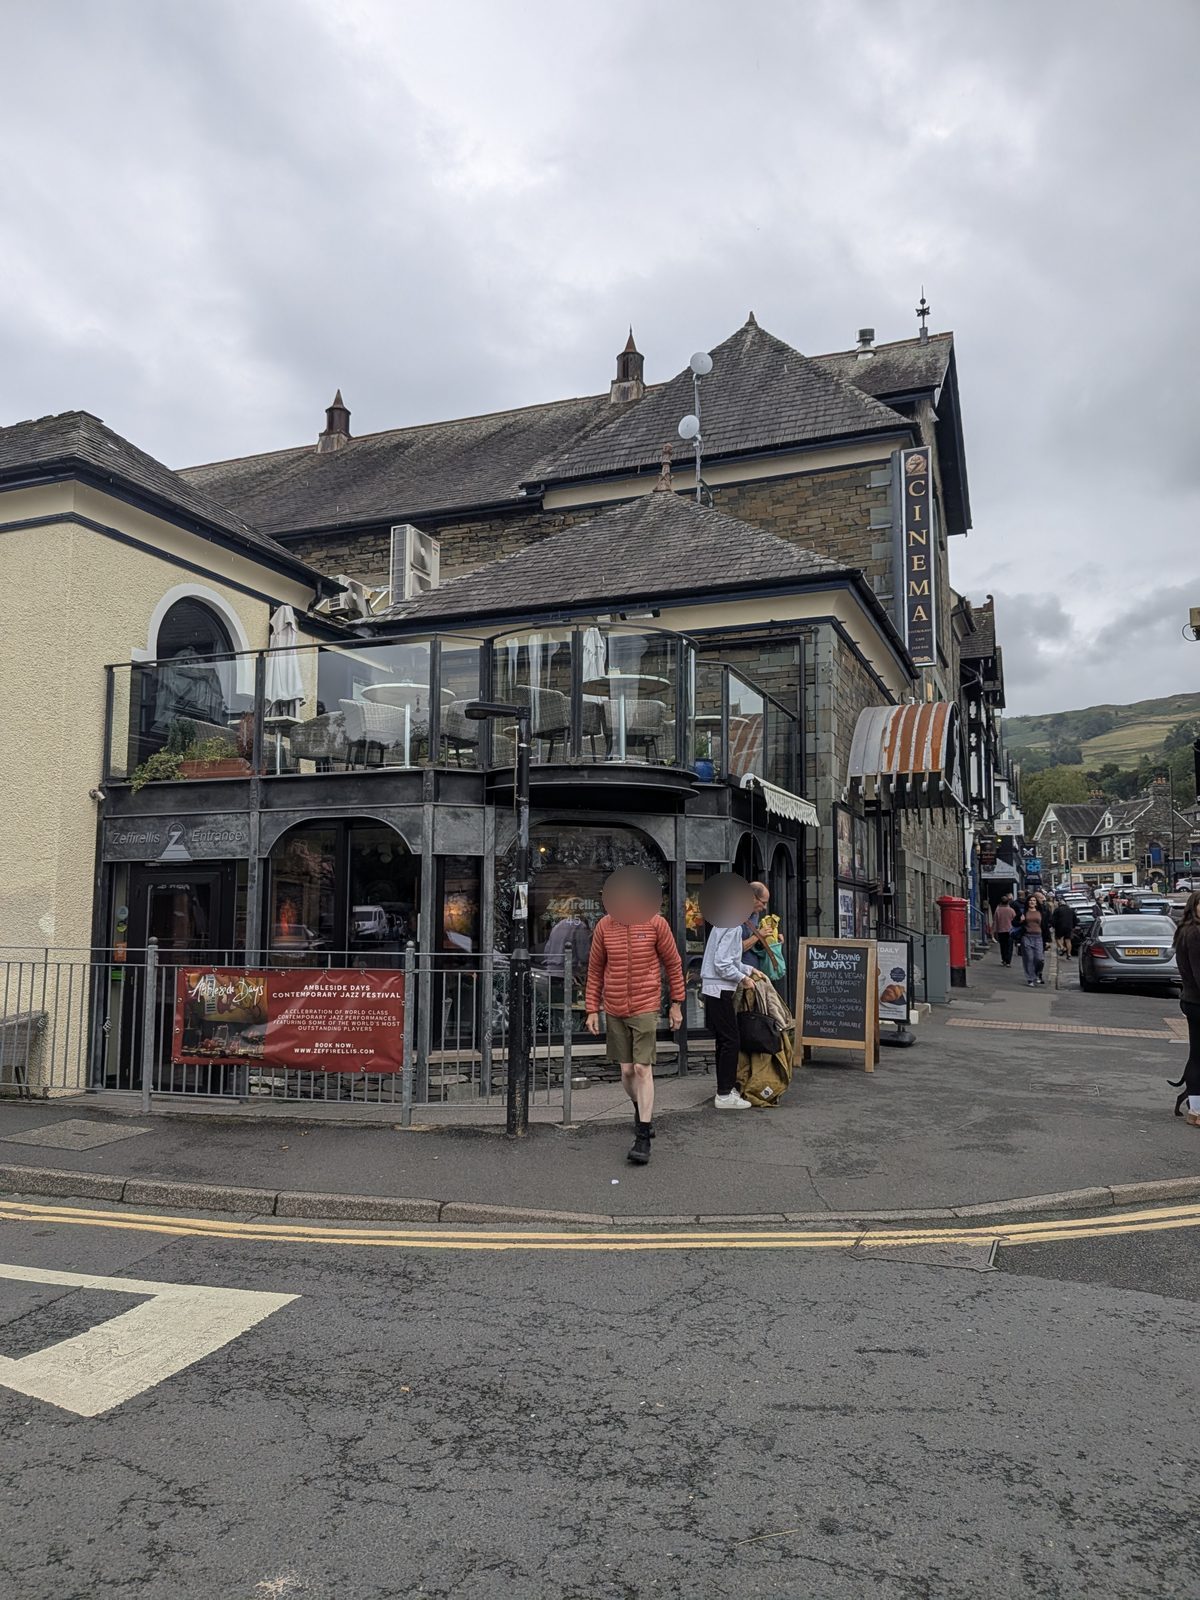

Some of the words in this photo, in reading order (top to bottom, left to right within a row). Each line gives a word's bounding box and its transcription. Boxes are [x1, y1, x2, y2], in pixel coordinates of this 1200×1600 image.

[908, 480, 930, 621] CINEMA
[113, 831, 160, 844] Zeffirellis
[191, 829, 241, 842] Entrance
[232, 977, 264, 1006] Days
